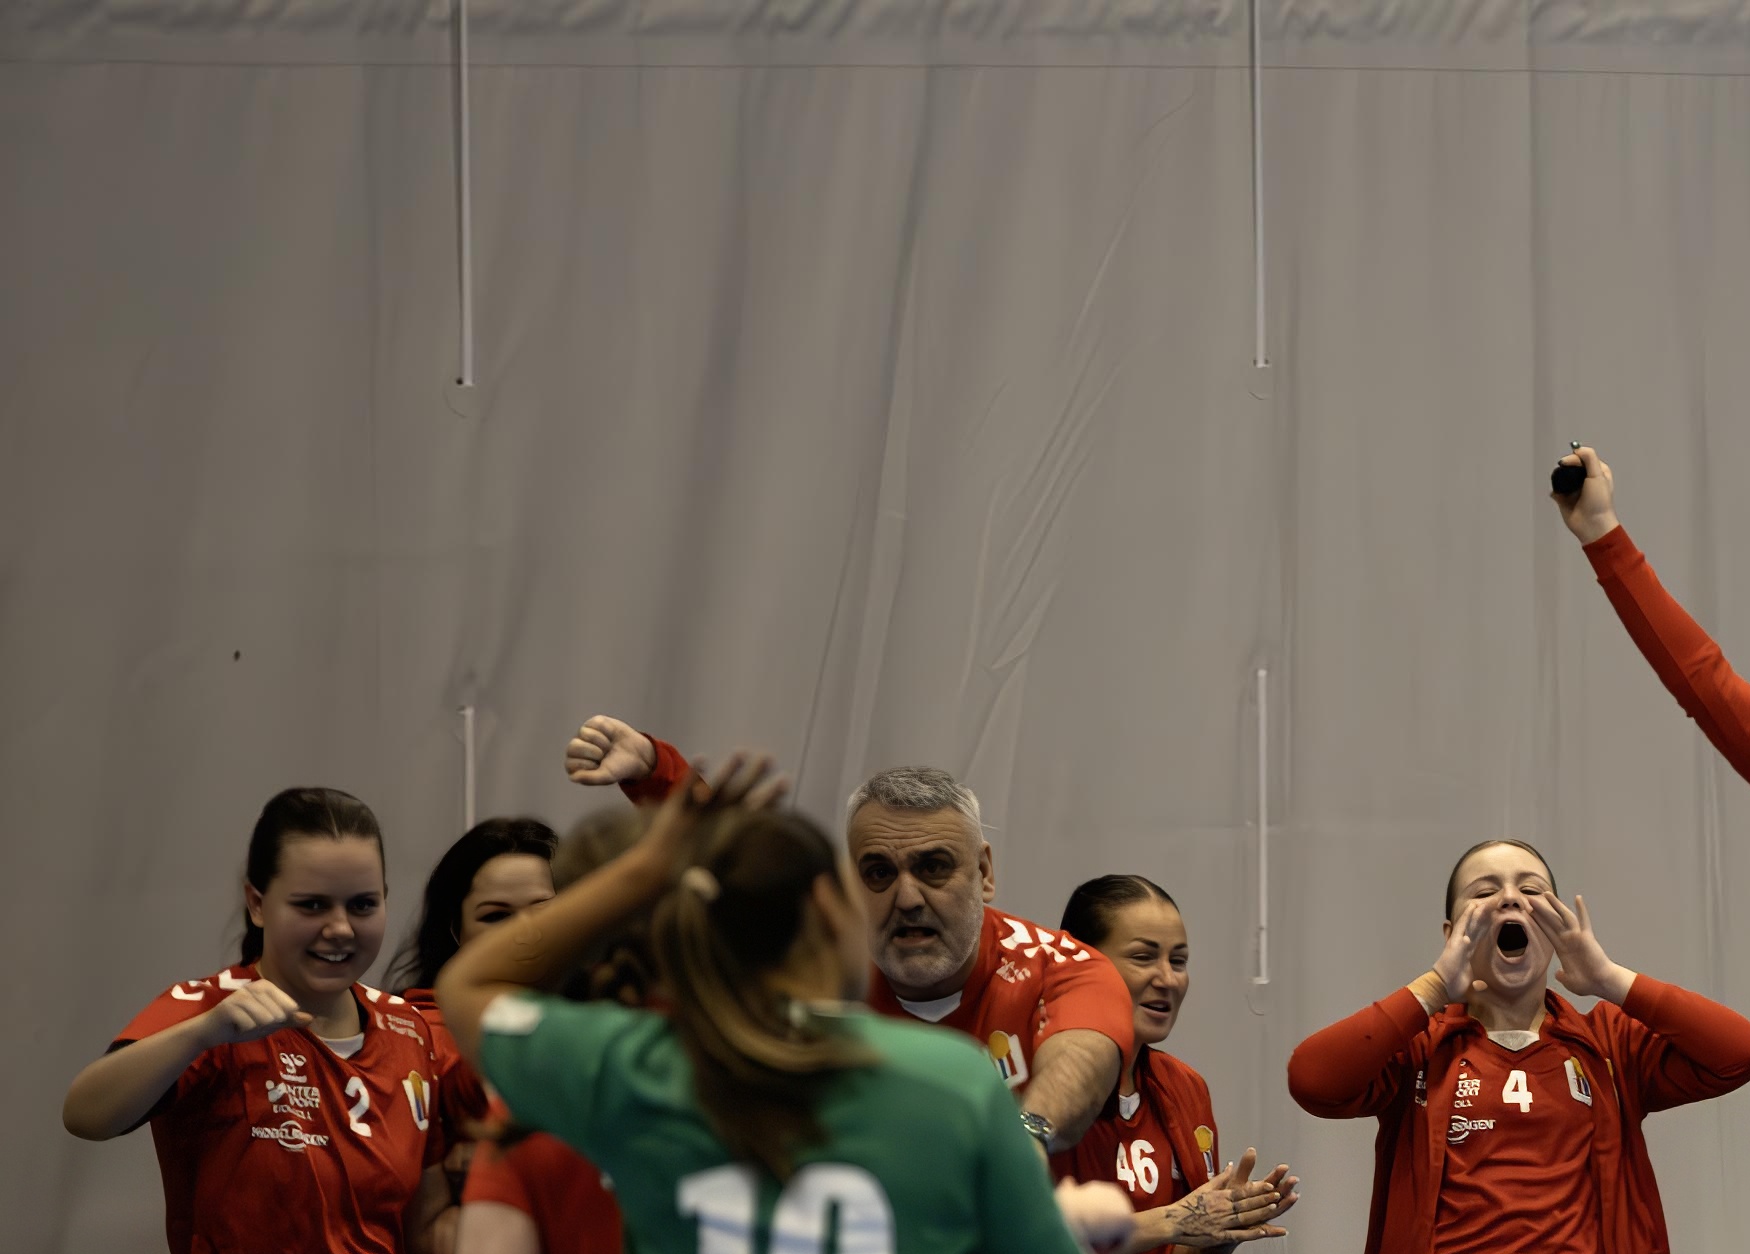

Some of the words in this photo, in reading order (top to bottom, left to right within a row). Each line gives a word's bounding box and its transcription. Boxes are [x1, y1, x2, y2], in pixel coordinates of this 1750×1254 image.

[344, 1076, 372, 1138] 2
[1502, 1069, 1533, 1113] 4
[1116, 1139, 1159, 1194] 46
